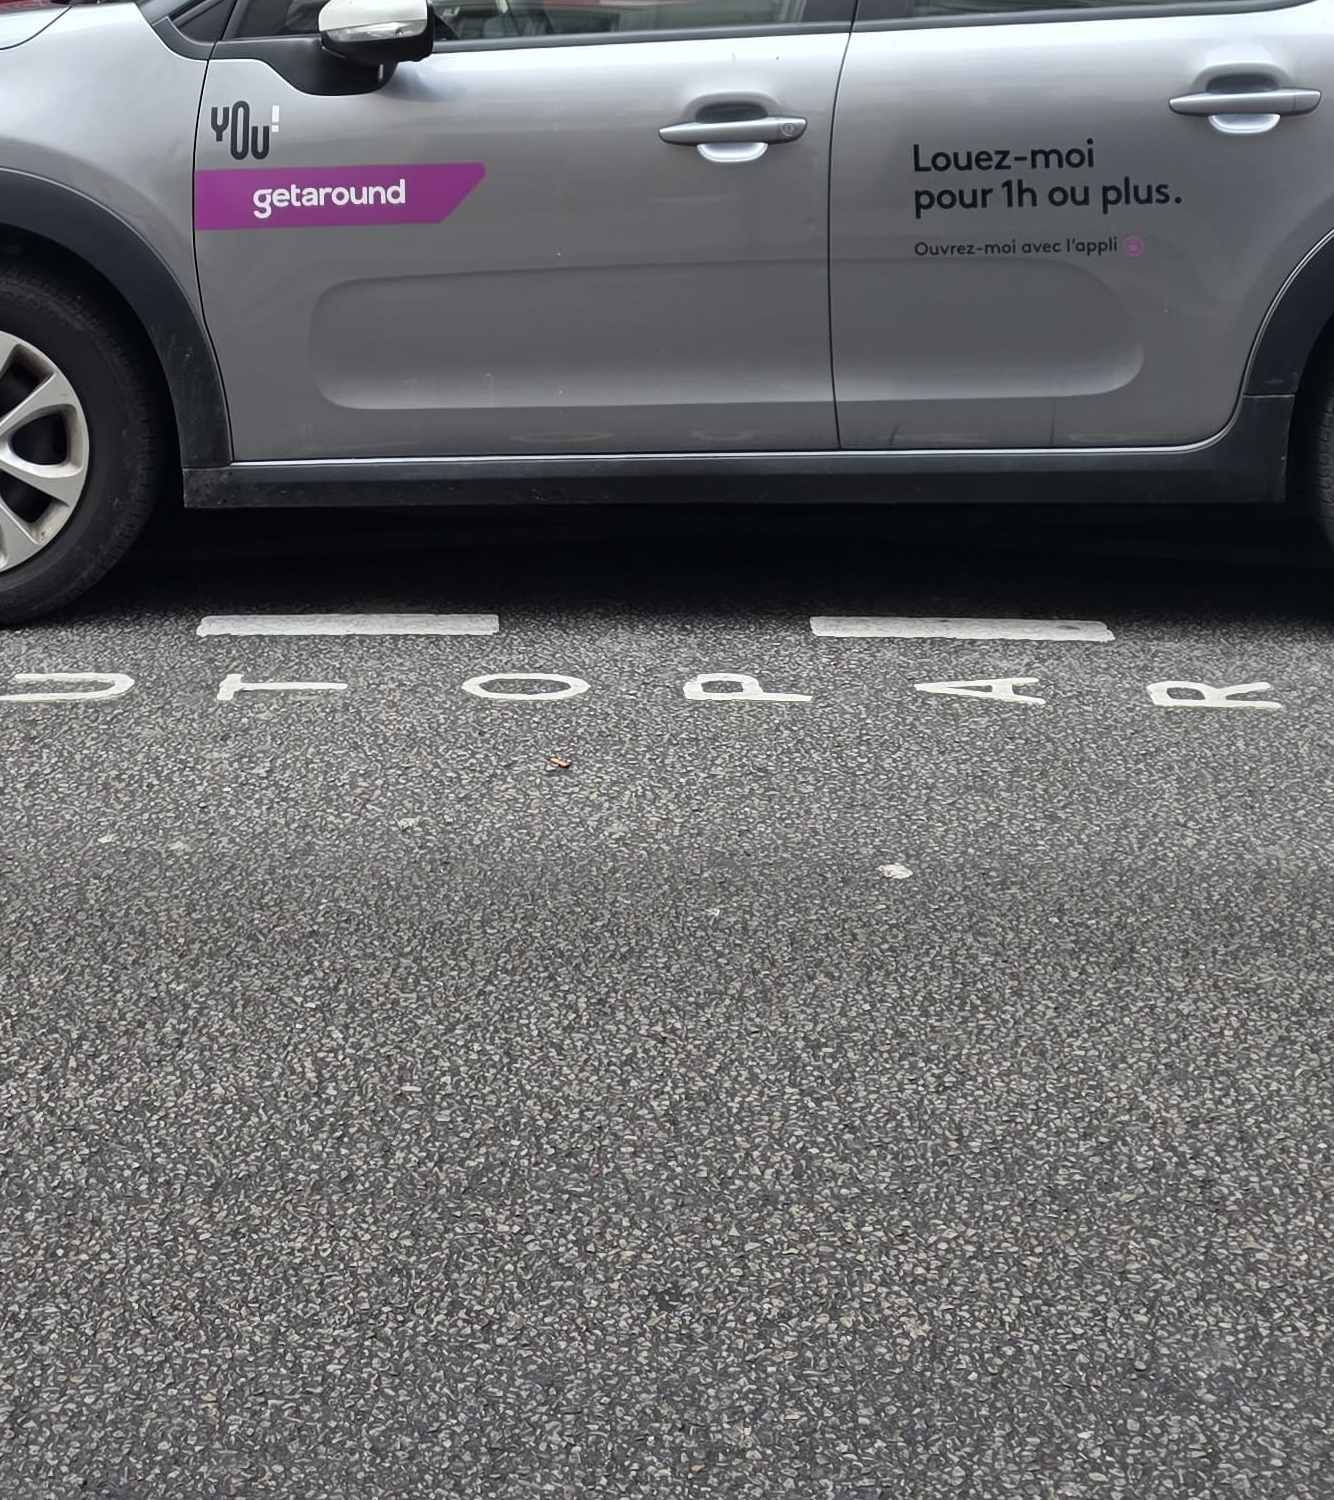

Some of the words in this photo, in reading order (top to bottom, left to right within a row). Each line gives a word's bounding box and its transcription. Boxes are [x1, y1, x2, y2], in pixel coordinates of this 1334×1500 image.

[211, 101, 280, 160] YOU!
[913, 138, 1094, 172] Louez-moi
[253, 179, 406, 219] getaround
[914, 188, 993, 219] pour
[1001, 179, 1037, 208] 1h
[1048, 183, 1089, 207] ou
[1102, 176, 1182, 214] plus.
[915, 238, 1017, 257] Ouvrez-moi
[1021, 240, 1062, 254] avec
[1066, 236, 1117, 256] l'appli
